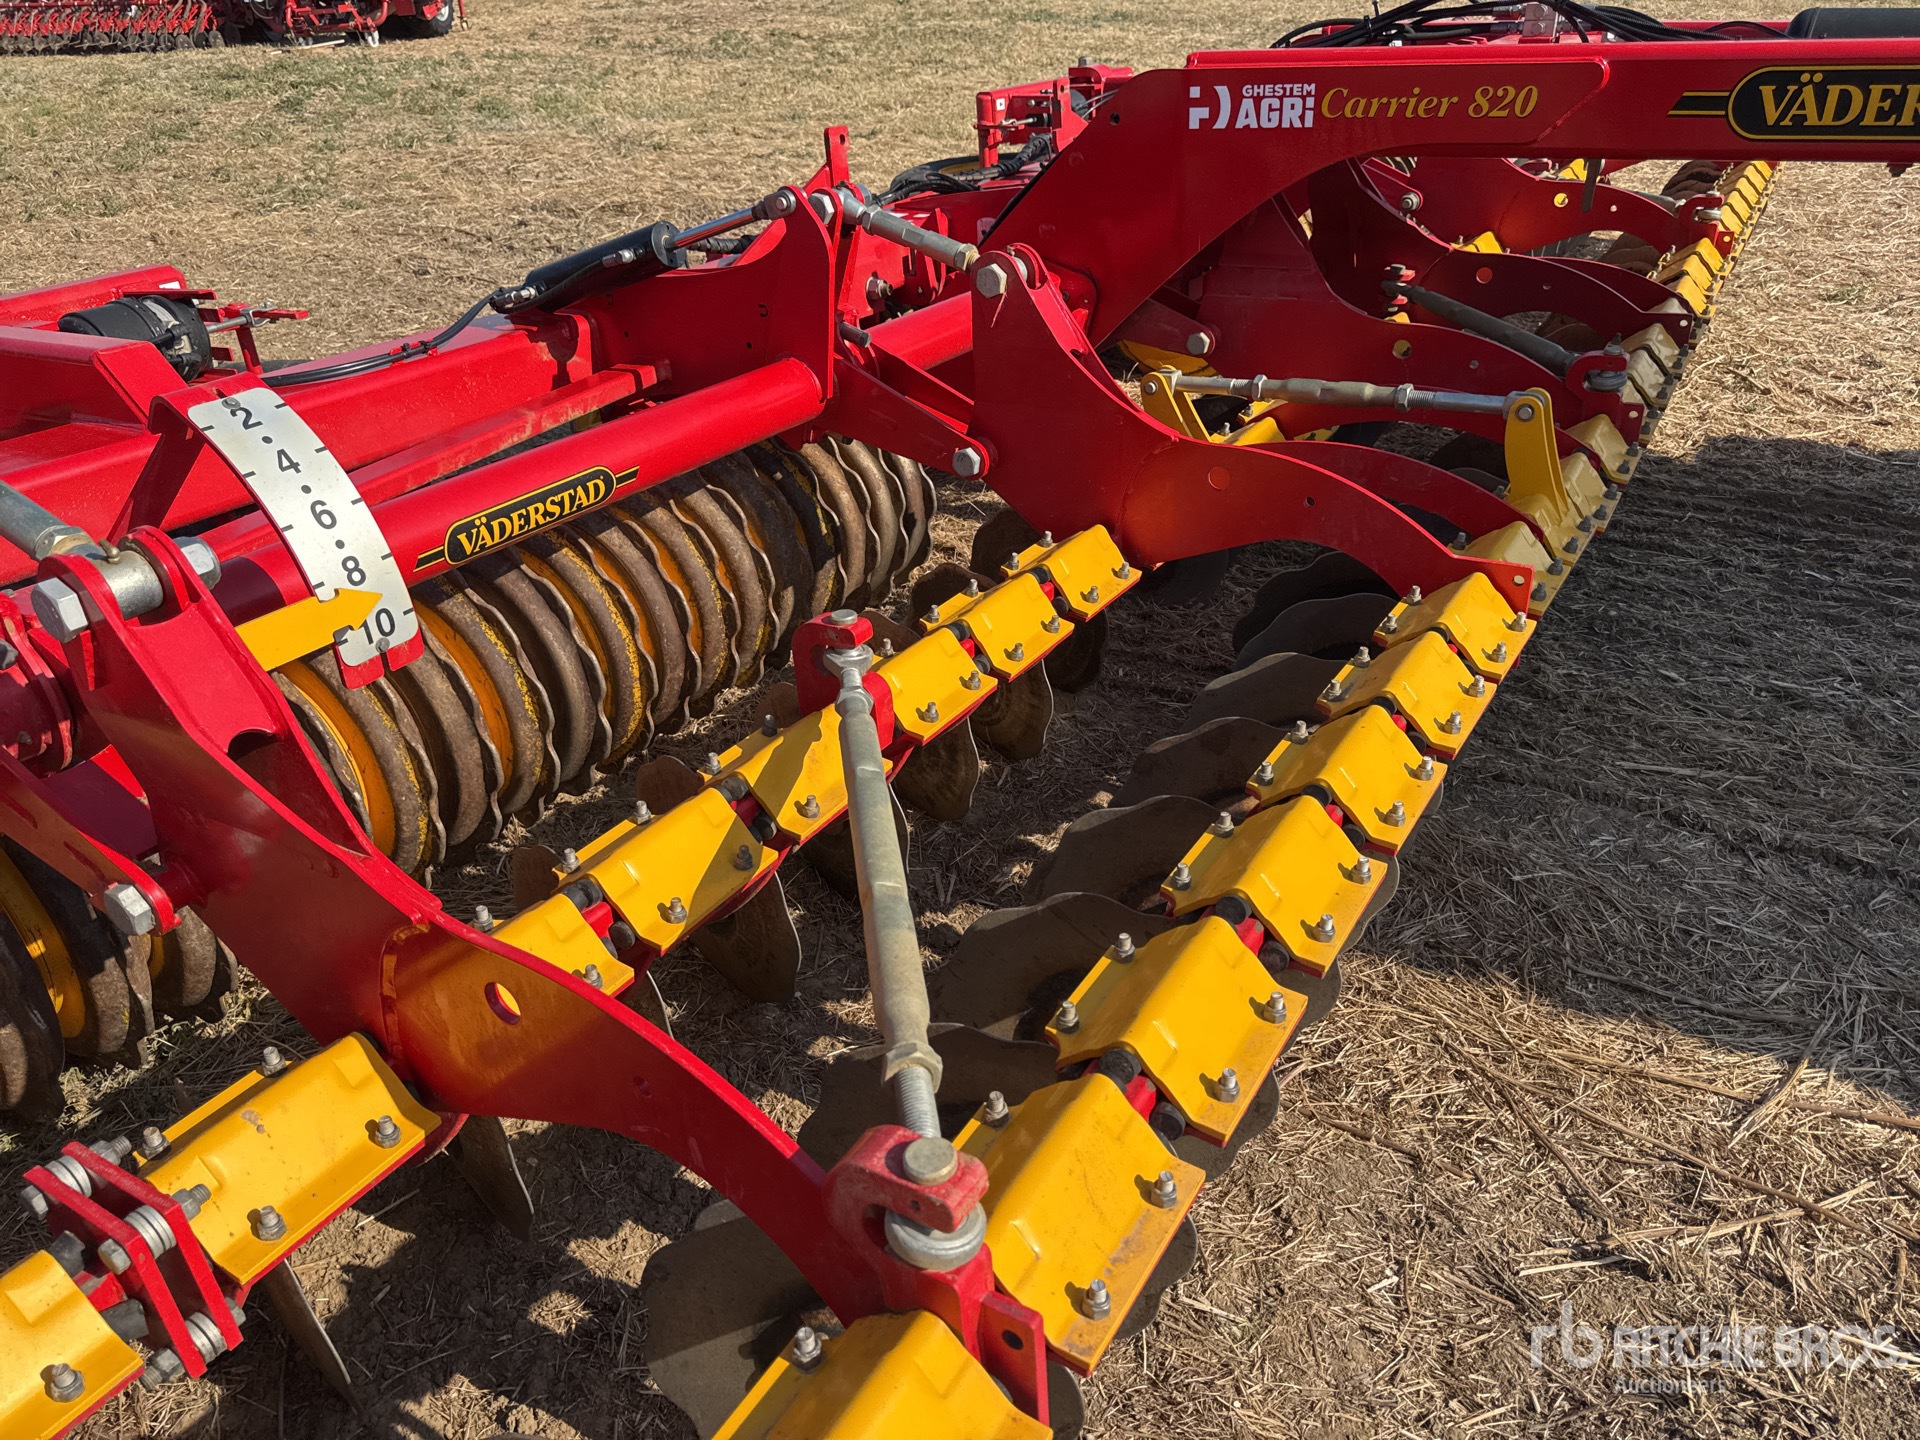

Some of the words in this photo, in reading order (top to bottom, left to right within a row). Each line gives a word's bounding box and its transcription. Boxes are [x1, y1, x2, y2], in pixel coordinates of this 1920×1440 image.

[1242, 83, 1316, 97] GHESTEM
[1321, 87, 1459, 119] Carrier
[1467, 85, 1539, 118] 820
[230, 406, 263, 430] 2
[276, 448, 301, 474] 4
[310, 500, 337, 529] 6
[457, 479, 605, 556] VÄDERSTAD
[341, 556, 366, 586] 8
[361, 607, 396, 645] 10
